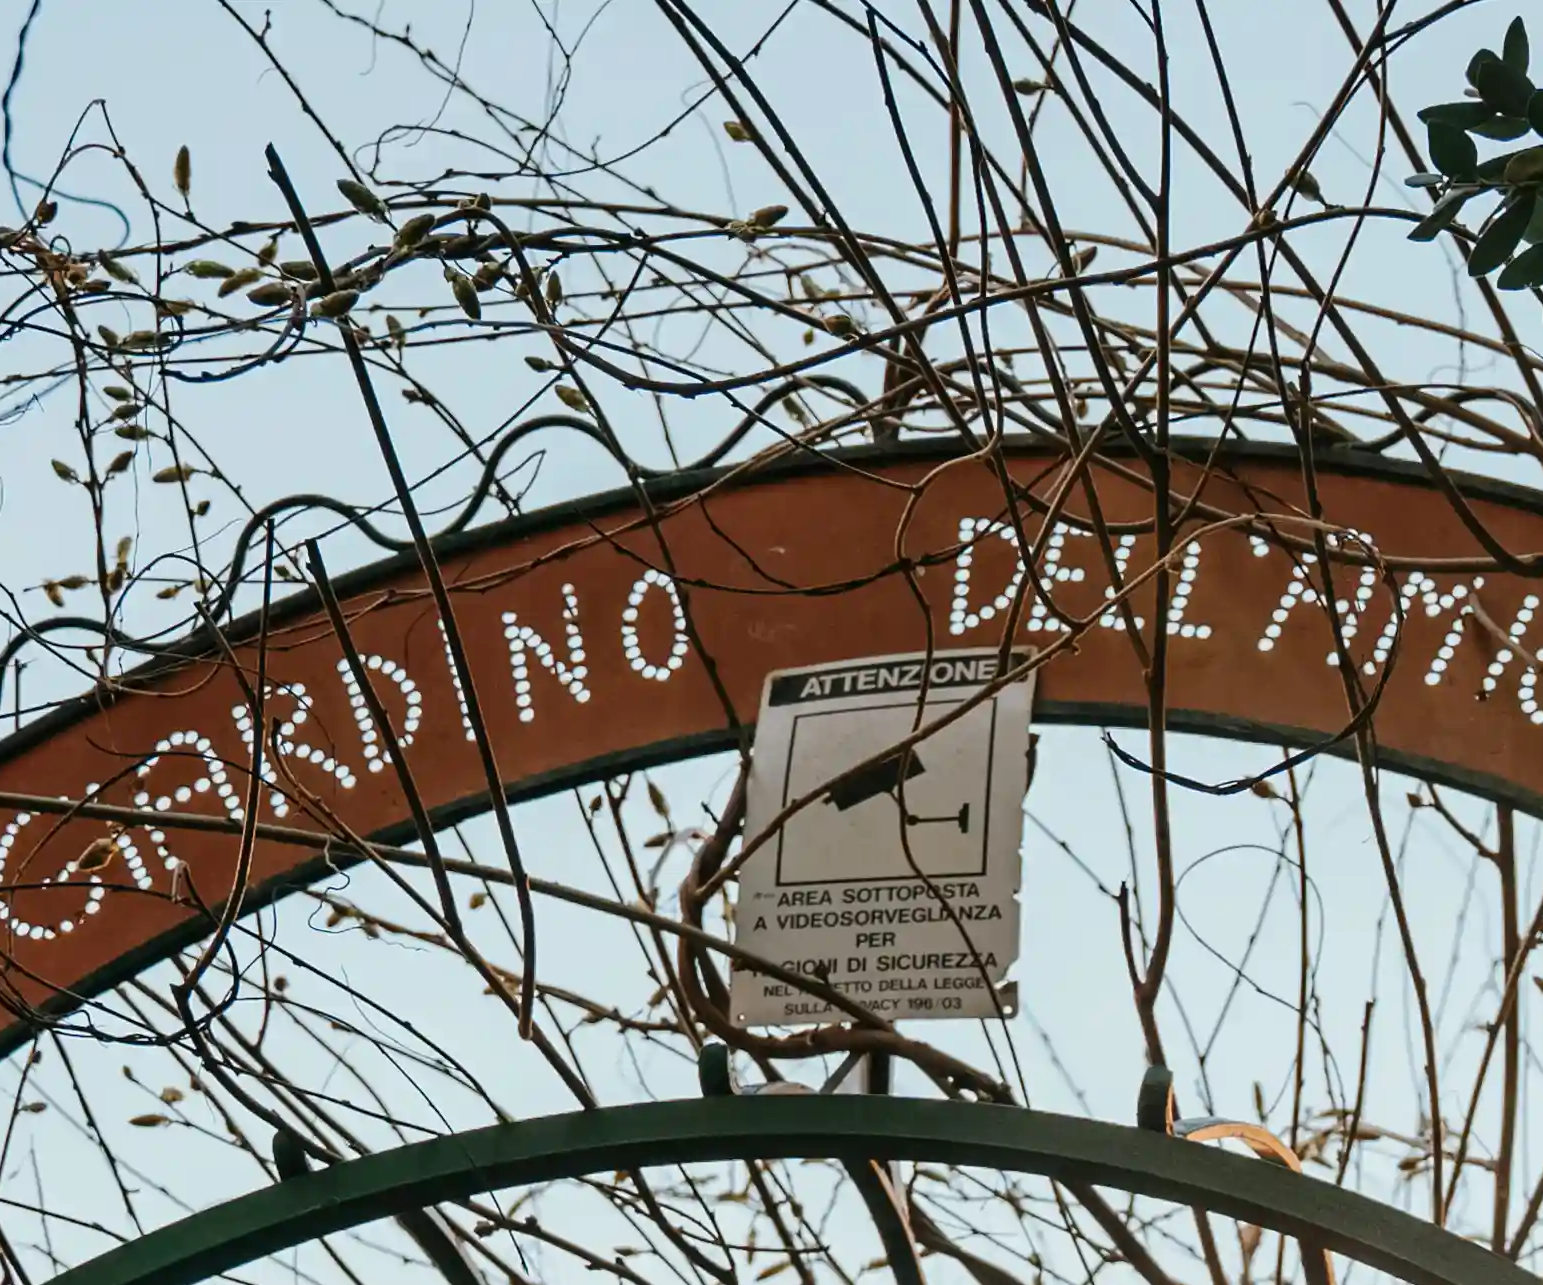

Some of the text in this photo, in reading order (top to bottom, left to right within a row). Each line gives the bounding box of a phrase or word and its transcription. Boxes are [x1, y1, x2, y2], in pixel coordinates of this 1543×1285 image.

[799, 659, 999, 698] ATTENZONE
[777, 882, 980, 908] AREA SOTTOPOSTA
[753, 916, 768, 932] A
[856, 931, 896, 949] PER
[847, 957, 867, 973] DI
[876, 951, 998, 972] SICUREZZA
[763, 984, 794, 998] NEL
[878, 977, 928, 992] DELLA
[933, 976, 985, 990] LEGGE
[783, 1001, 834, 1016] SULLA
